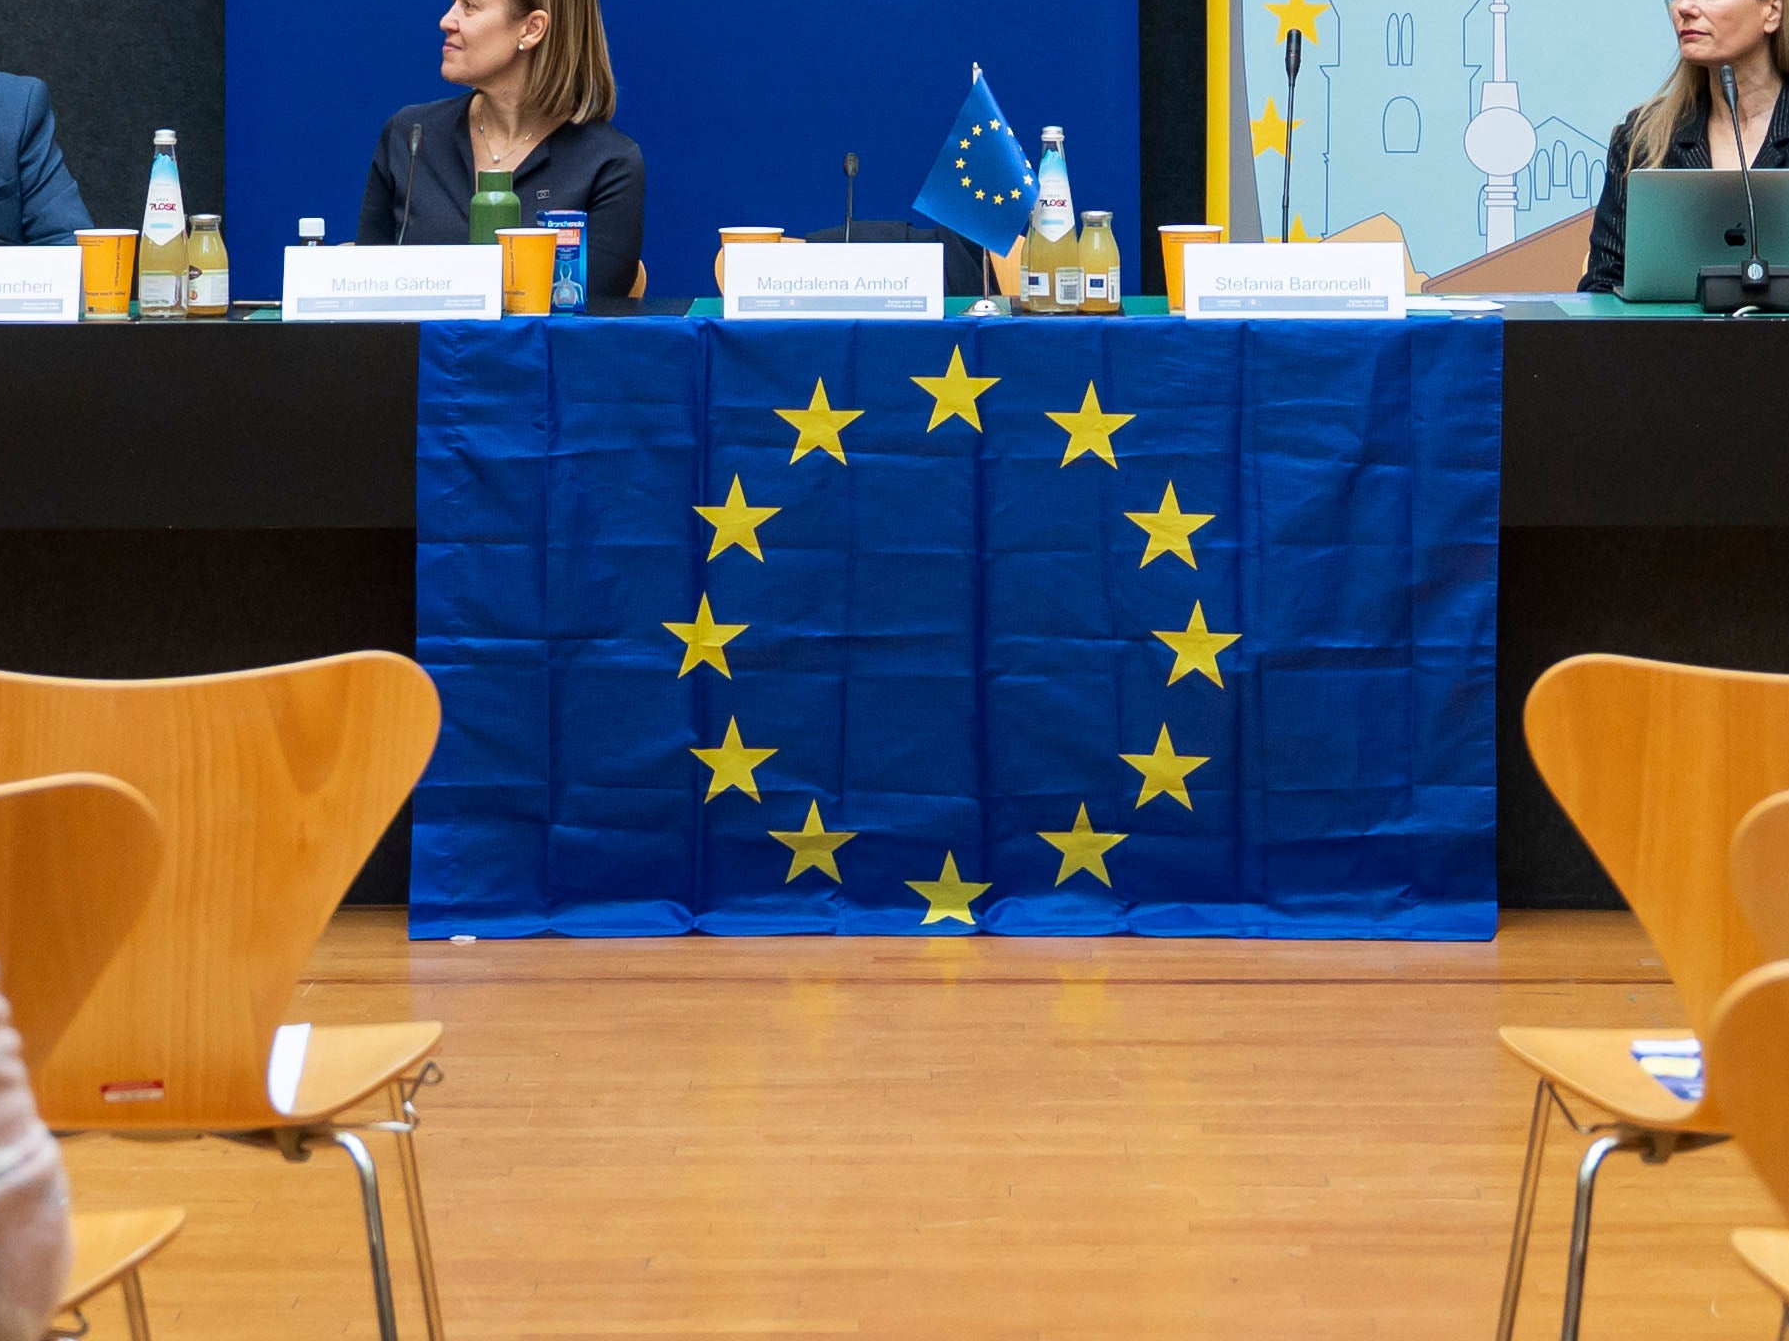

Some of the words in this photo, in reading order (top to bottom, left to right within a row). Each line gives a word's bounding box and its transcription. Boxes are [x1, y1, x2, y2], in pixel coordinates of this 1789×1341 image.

[332, 278, 389, 292] Martha
[395, 277, 452, 291] Gärber
[757, 277, 849, 294] Magdalena
[854, 277, 909, 291] Amhof
[1215, 277, 1283, 291] Stefania
[1290, 277, 1370, 291] Baroncelli
